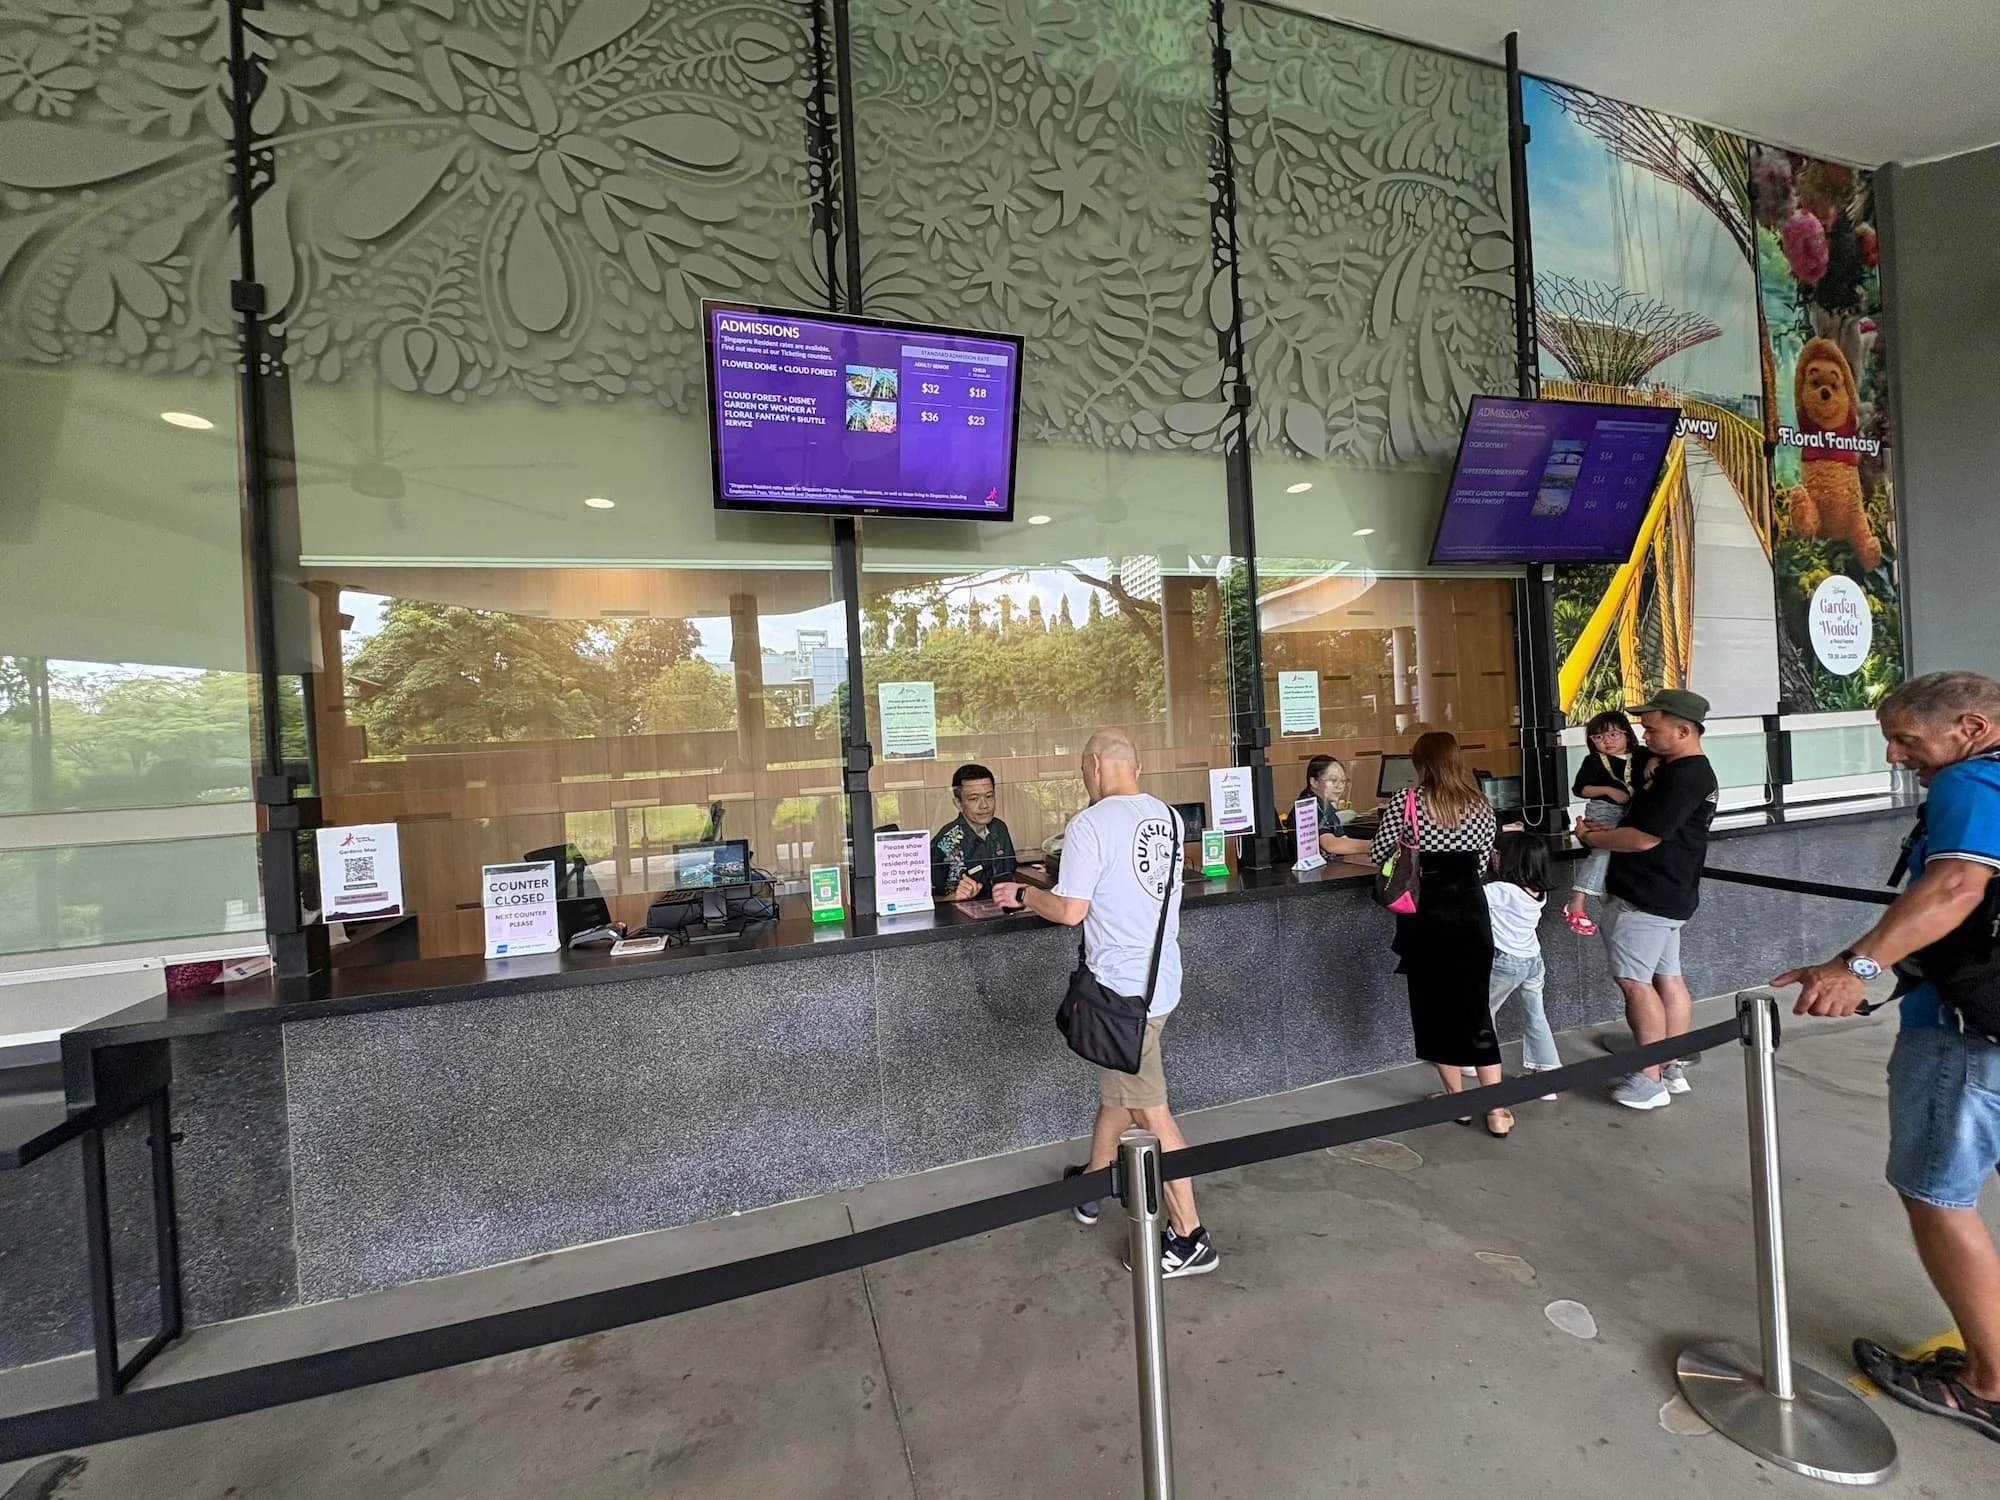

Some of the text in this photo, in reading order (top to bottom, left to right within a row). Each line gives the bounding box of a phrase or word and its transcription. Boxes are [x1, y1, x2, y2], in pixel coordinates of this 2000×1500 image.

[720, 320, 800, 338] ADMISSIONS
[754, 338, 778, 348] Resident
[781, 350, 806, 359] Ticketing
[722, 360, 754, 370] FLOWER
[754, 362, 778, 372] DOME
[784, 365, 810, 375] CLOUD
[810, 368, 837, 377] FOREST
[922, 382, 987, 398] $32 $18
[724, 391, 751, 400] CLOUD
[752, 393, 782, 402] FOREST
[789, 396, 816, 406] DISNEY
[724, 401, 756, 410] GARDEN
[770, 404, 804, 414] WONDER
[1477, 408, 1530, 420] ADMISSIONS
[724, 410, 754, 420] FLORAL
[755, 412, 790, 422] FANTASY
[797, 416, 826, 425] SHUTTLE
[921, 411, 986, 426] $36 $23
[1675, 418, 1718, 440] yway
[1778, 427, 1880, 456] Floral Fantasy
[1820, 598, 1858, 618] Garden
[1819, 620, 1862, 636] Wonder
[490, 878, 549, 892] COUNTER
[495, 893, 544, 906] CLOSED
[514, 910, 546, 918] COUNTER
